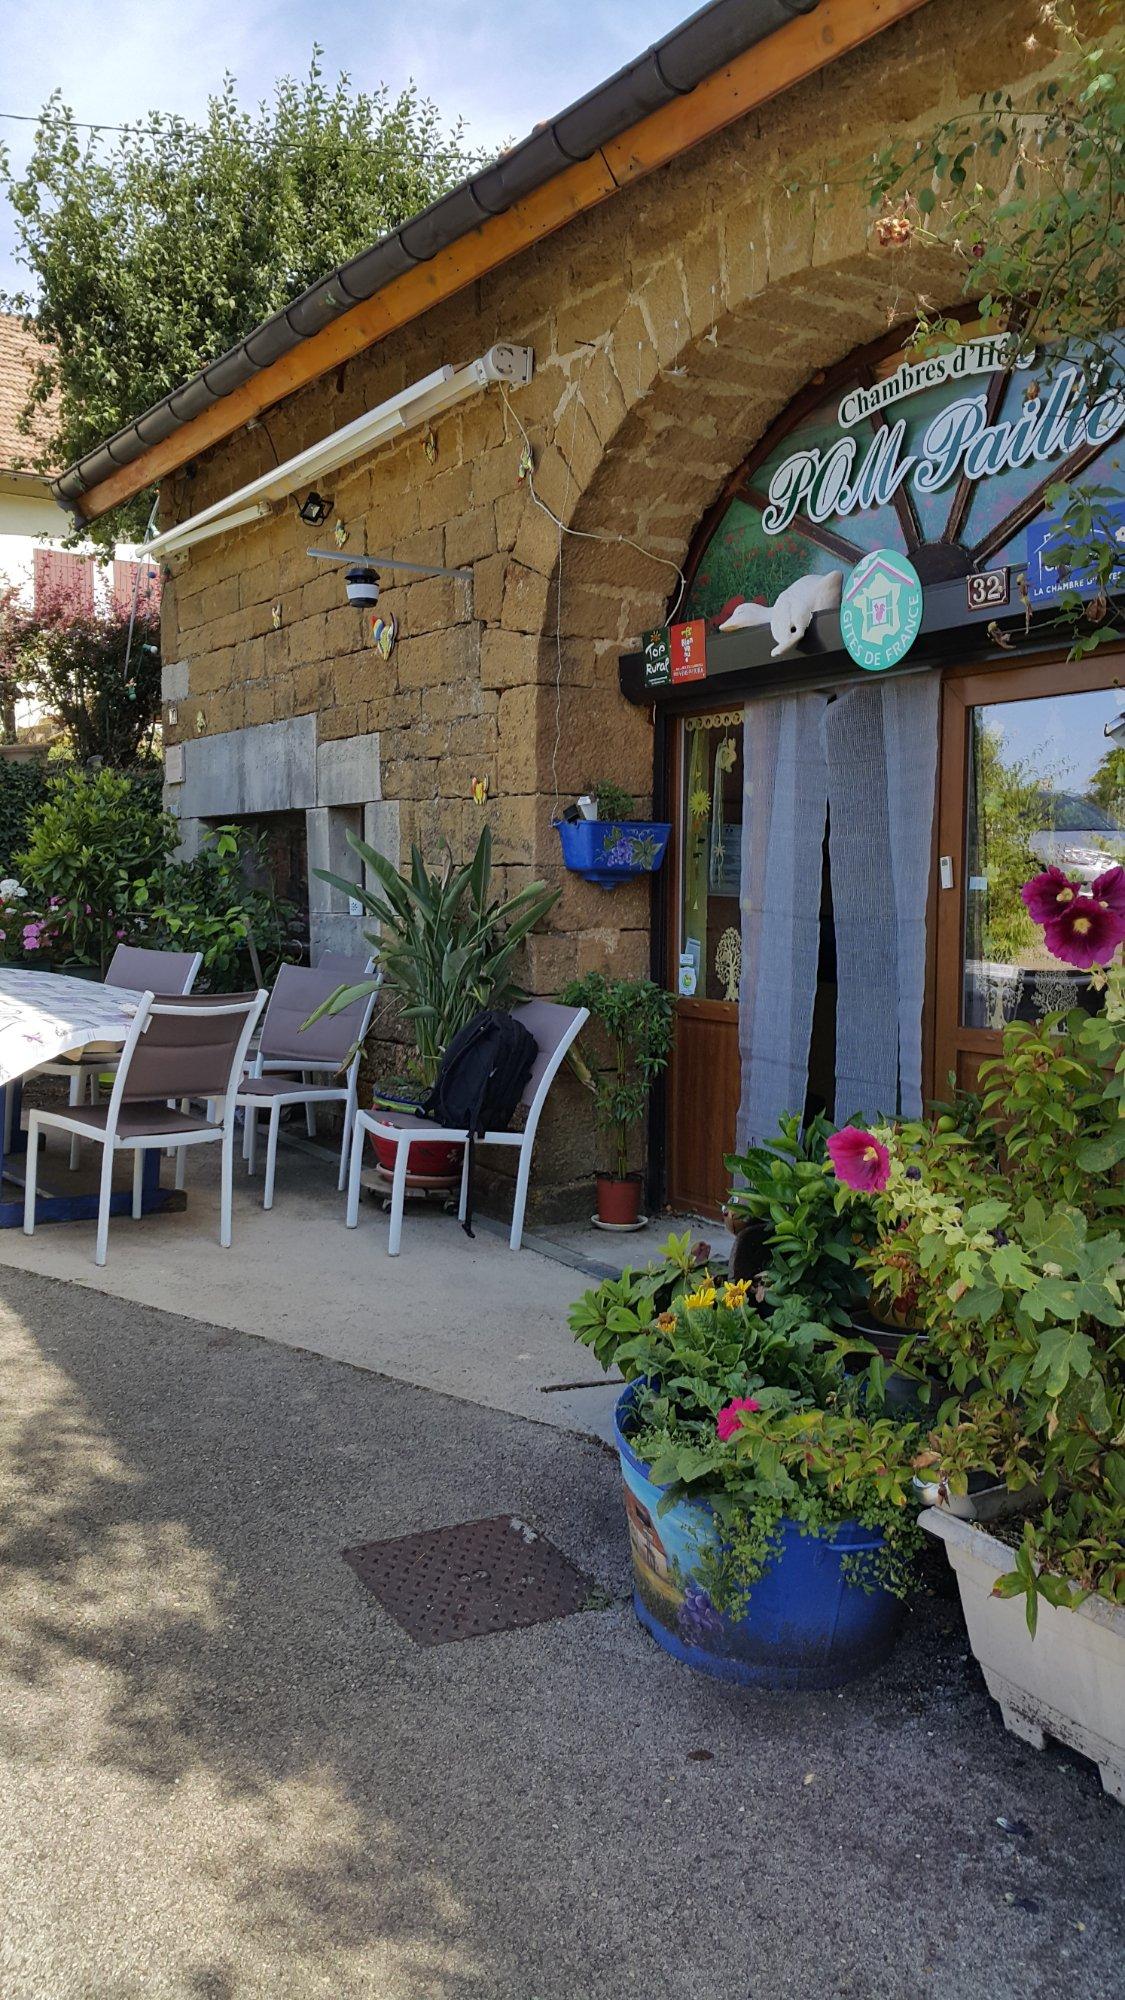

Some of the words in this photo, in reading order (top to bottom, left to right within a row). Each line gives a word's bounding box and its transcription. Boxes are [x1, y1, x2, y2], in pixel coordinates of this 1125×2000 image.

[840, 359, 945, 423] Chambres
[973, 576, 1000, 602] 32
[1034, 588, 1044, 596] LA
[1046, 579, 1083, 593] CHAMBRE
[864, 651, 881, 666] DE
[885, 594, 919, 662] FRANCE
[645, 642, 665, 661] Top
[646, 657, 669, 675] Rural
